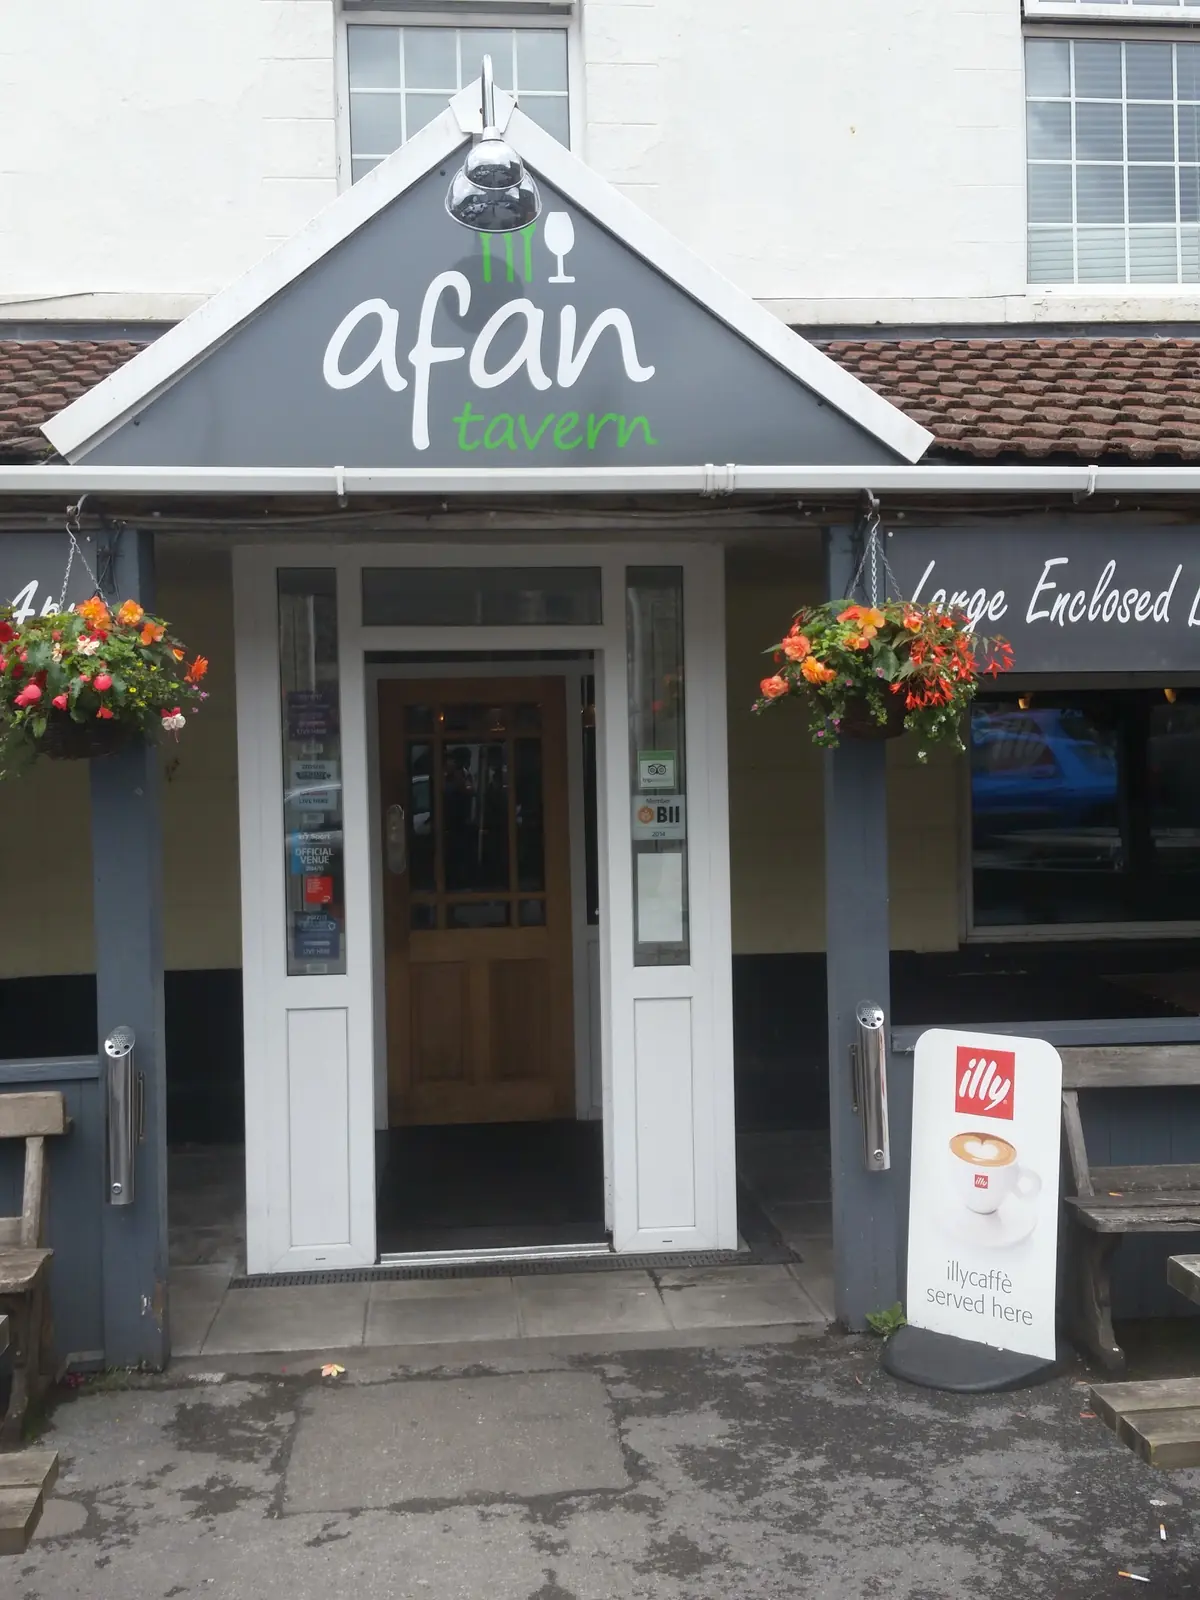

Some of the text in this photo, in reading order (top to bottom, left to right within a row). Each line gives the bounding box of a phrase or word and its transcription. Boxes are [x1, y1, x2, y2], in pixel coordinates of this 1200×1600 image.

[323, 270, 656, 450] afan
[452, 401, 660, 450] tavern
[1025, 557, 1183, 627] Enclosed
[294, 847, 335, 856] OFFICIAL
[300, 855, 330, 865] VENUE
[959, 1058, 1011, 1111] illy
[975, 1176, 988, 1186] illy
[947, 1260, 1012, 1293] illycaffè
[926, 1288, 1033, 1326] served here
